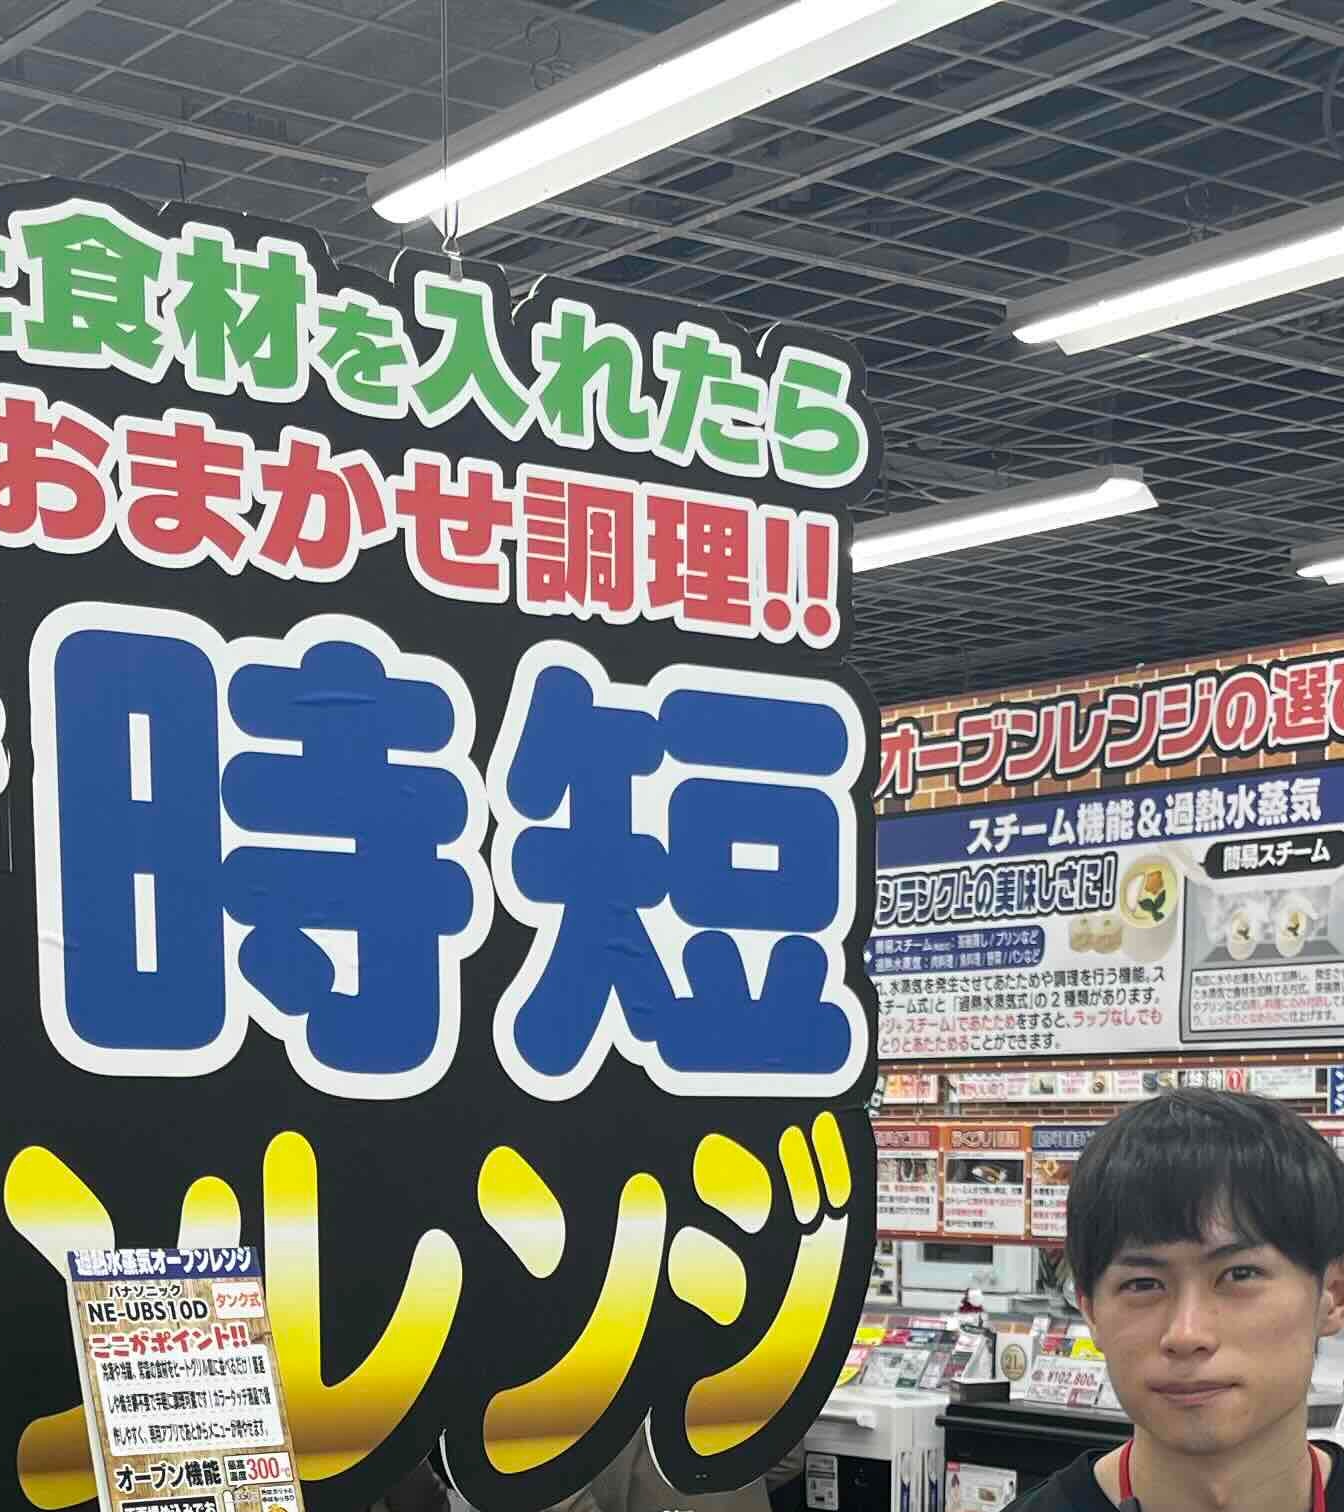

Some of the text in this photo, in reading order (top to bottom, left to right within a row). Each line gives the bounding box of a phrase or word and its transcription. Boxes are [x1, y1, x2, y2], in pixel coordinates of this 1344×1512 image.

[29, 600, 868, 1103] 時短
[1223, 838, 1331, 873] 簡易スチーム
[110, 1284, 181, 1299] パナソニック
[216, 1290, 262, 1308] タンク式
[88, 1300, 209, 1323] NE-UBS10D
[116, 1459, 222, 1492] オーブン機能
